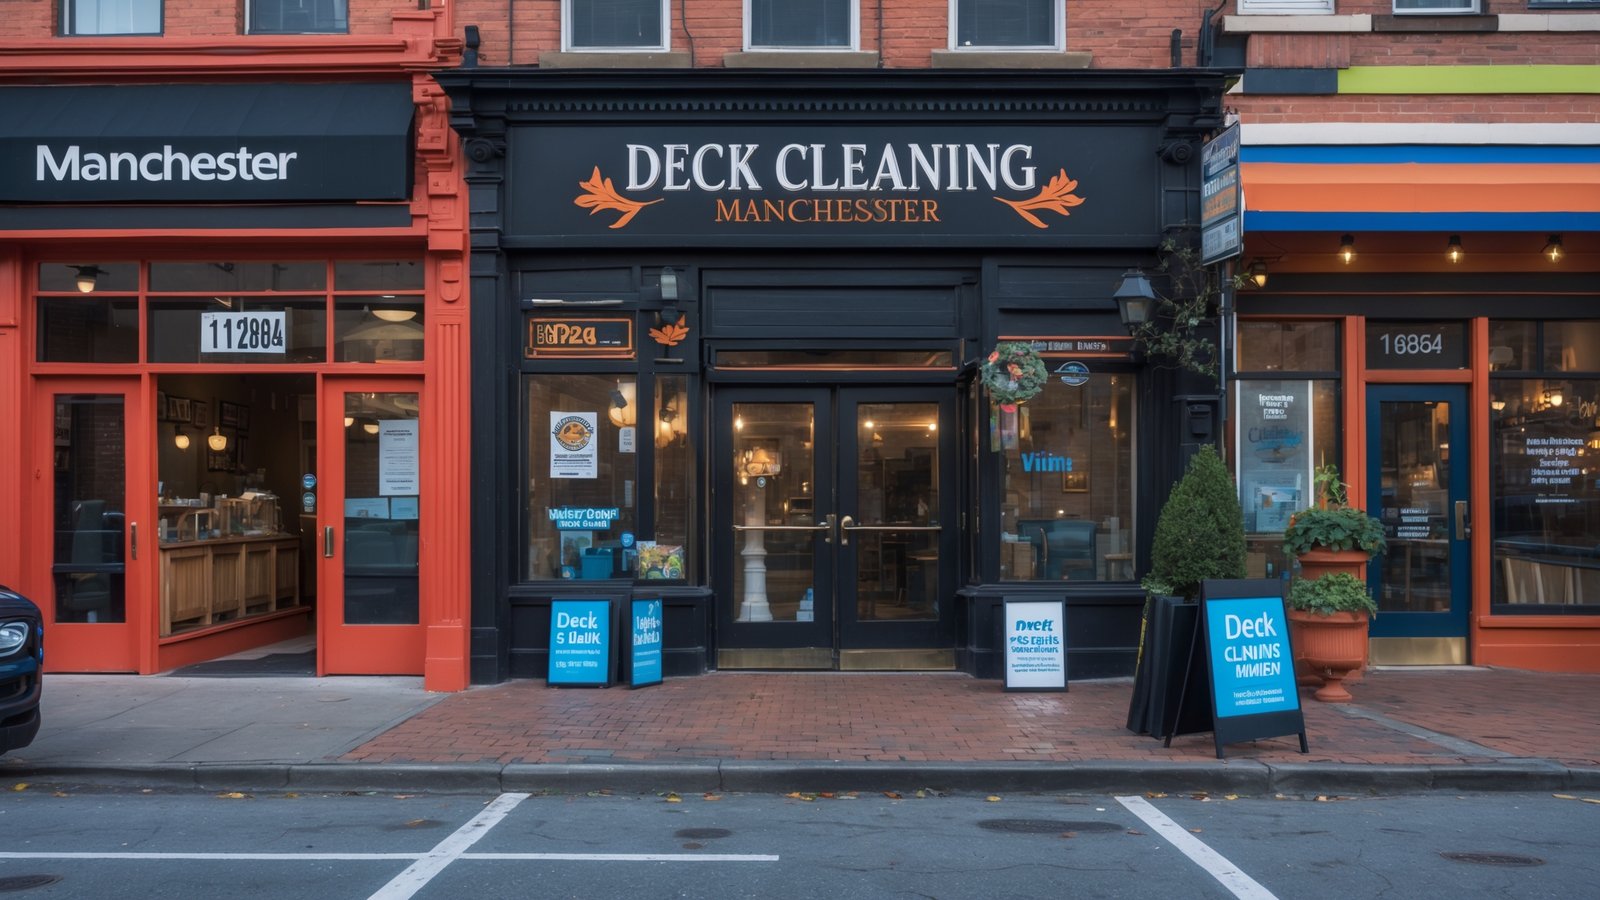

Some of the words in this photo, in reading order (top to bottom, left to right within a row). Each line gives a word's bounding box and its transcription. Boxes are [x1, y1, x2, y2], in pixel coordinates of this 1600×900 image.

[36, 144, 298, 181] Manchester
[625, 143, 763, 192] DECK
[775, 142, 1038, 192] CLEANING
[714, 198, 942, 223] MANCHESSTER
[557, 610, 598, 629] Deck
[1224, 611, 1278, 640] Deck
